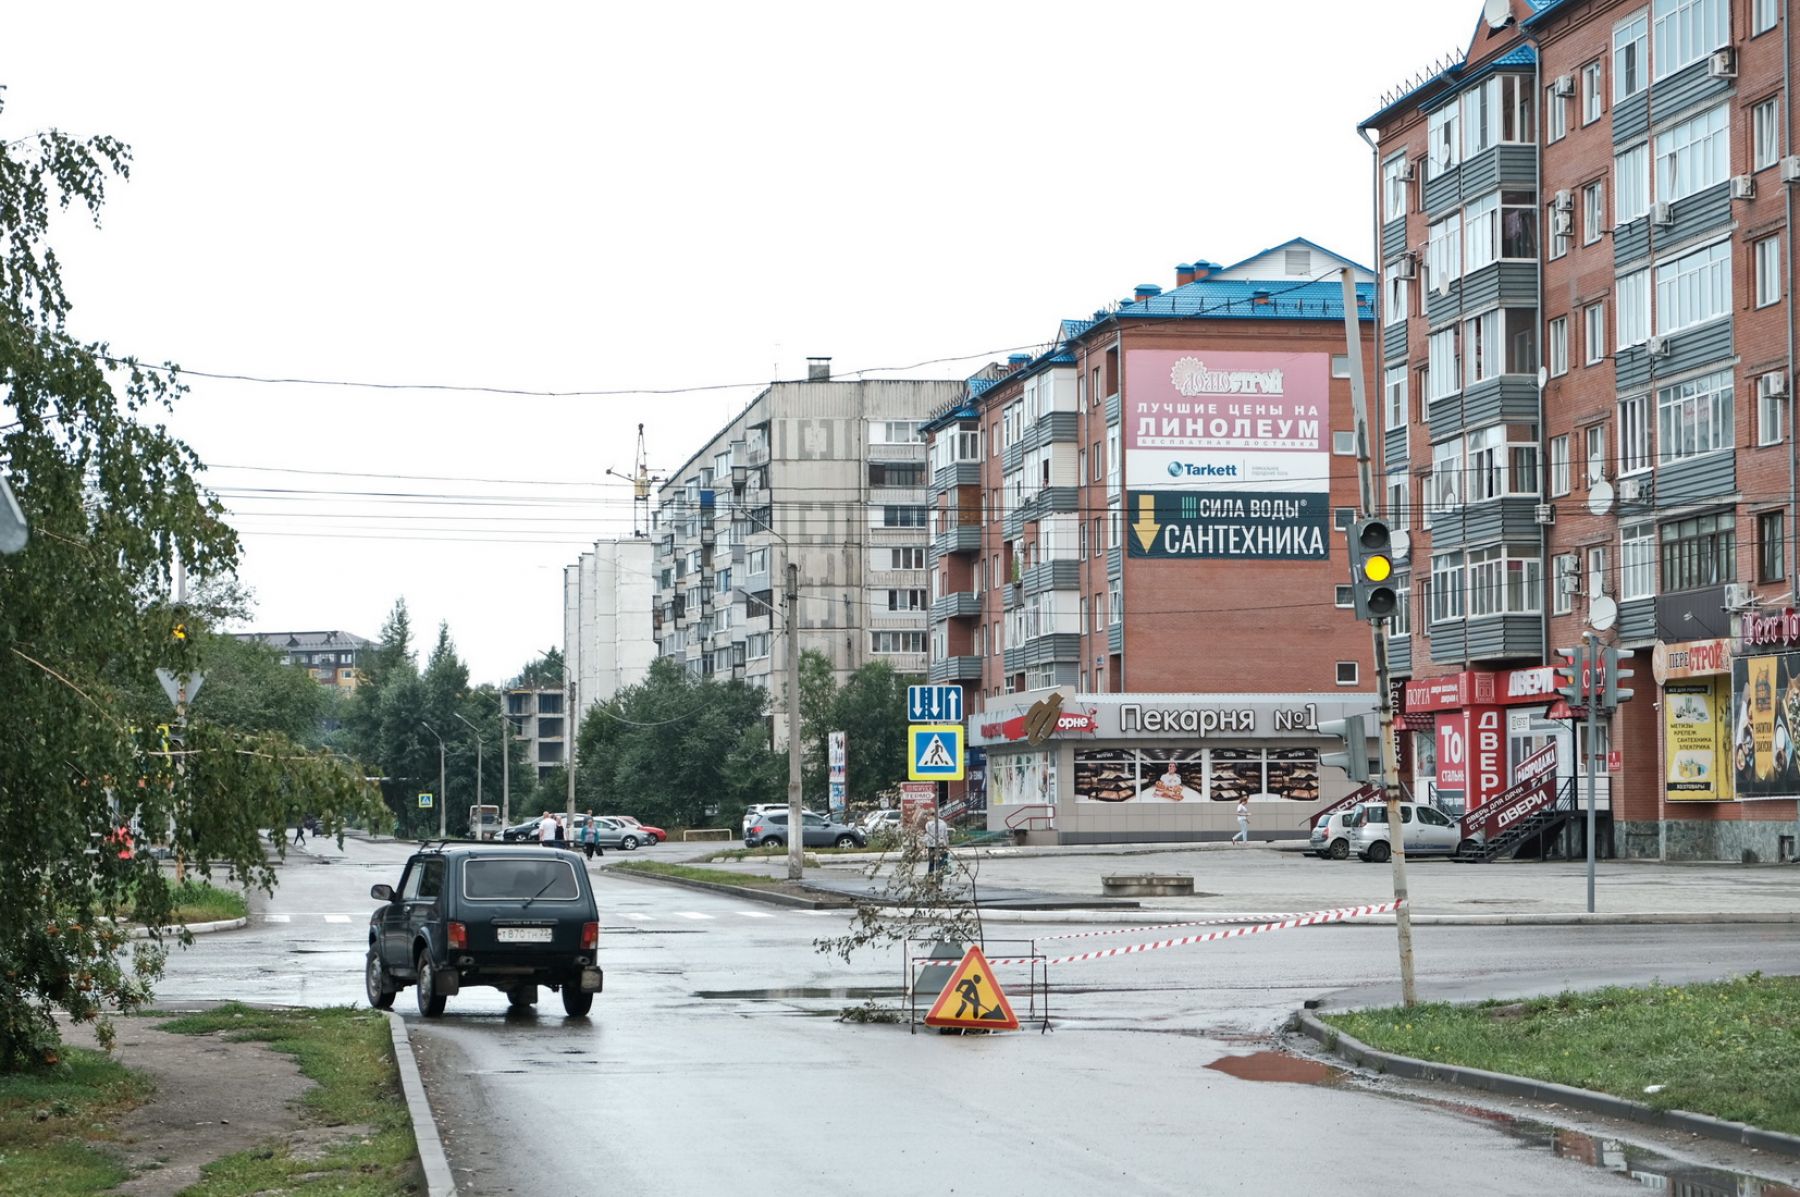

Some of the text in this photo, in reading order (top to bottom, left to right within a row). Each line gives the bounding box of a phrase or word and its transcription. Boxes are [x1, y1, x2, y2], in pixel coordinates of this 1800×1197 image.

[1137, 403, 1318, 416] ЛУЧШИЕ ЦЕНЫ НА
[1137, 418, 1319, 438] ЛИНОЛЕУМ
[1184, 463, 1237, 476] Tarkett
[1200, 499, 1245, 518] СИЛА
[1164, 524, 1325, 555] САНТЕХНИКА
[1508, 667, 1553, 697] ДВЕРИ
[1120, 703, 1318, 738] Пекарня №1
[1489, 799, 1504, 810] ДЛЯ
[1497, 789, 1548, 828] ДВЕРИ
